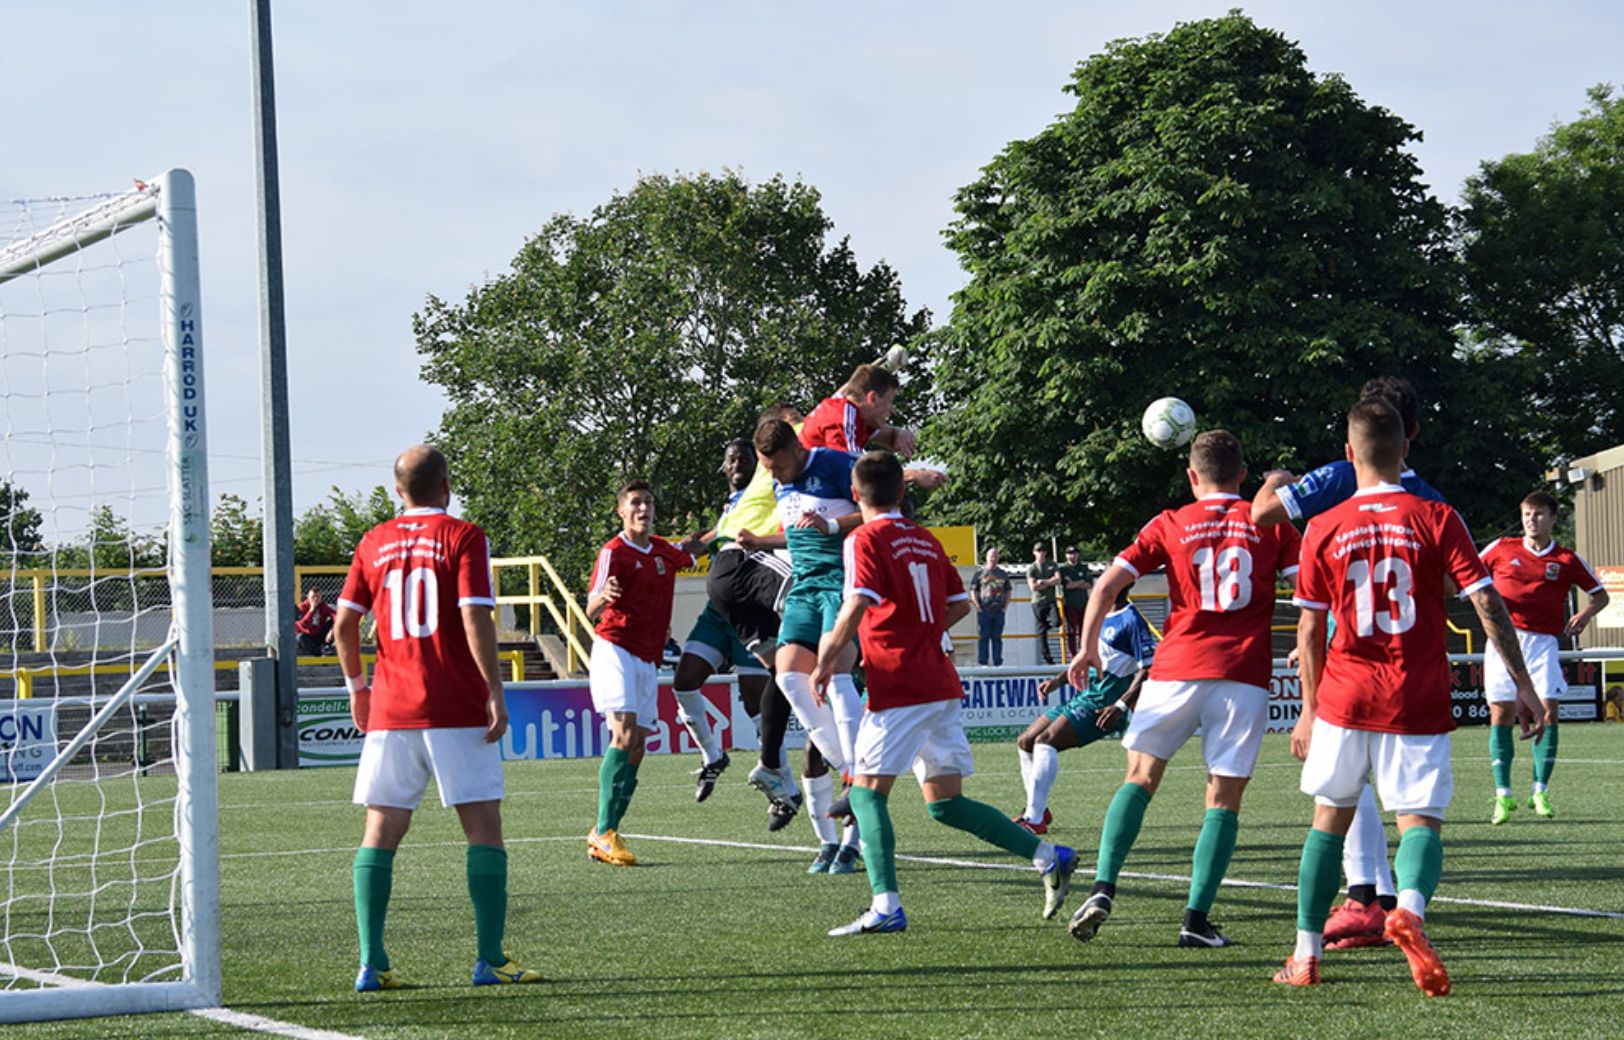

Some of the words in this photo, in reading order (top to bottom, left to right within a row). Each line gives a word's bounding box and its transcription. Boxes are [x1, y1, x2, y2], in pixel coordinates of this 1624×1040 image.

[180, 319, 197, 400] HARROD
[184, 405, 197, 432] UK
[383, 566, 439, 641] 10
[908, 561, 935, 624] 11
[1192, 546, 1253, 611] 18
[1346, 557, 1417, 638] 13
[960, 678, 1050, 709] GATEWAY
[1468, 704, 1491, 718] 86
[502, 706, 673, 760] utila
